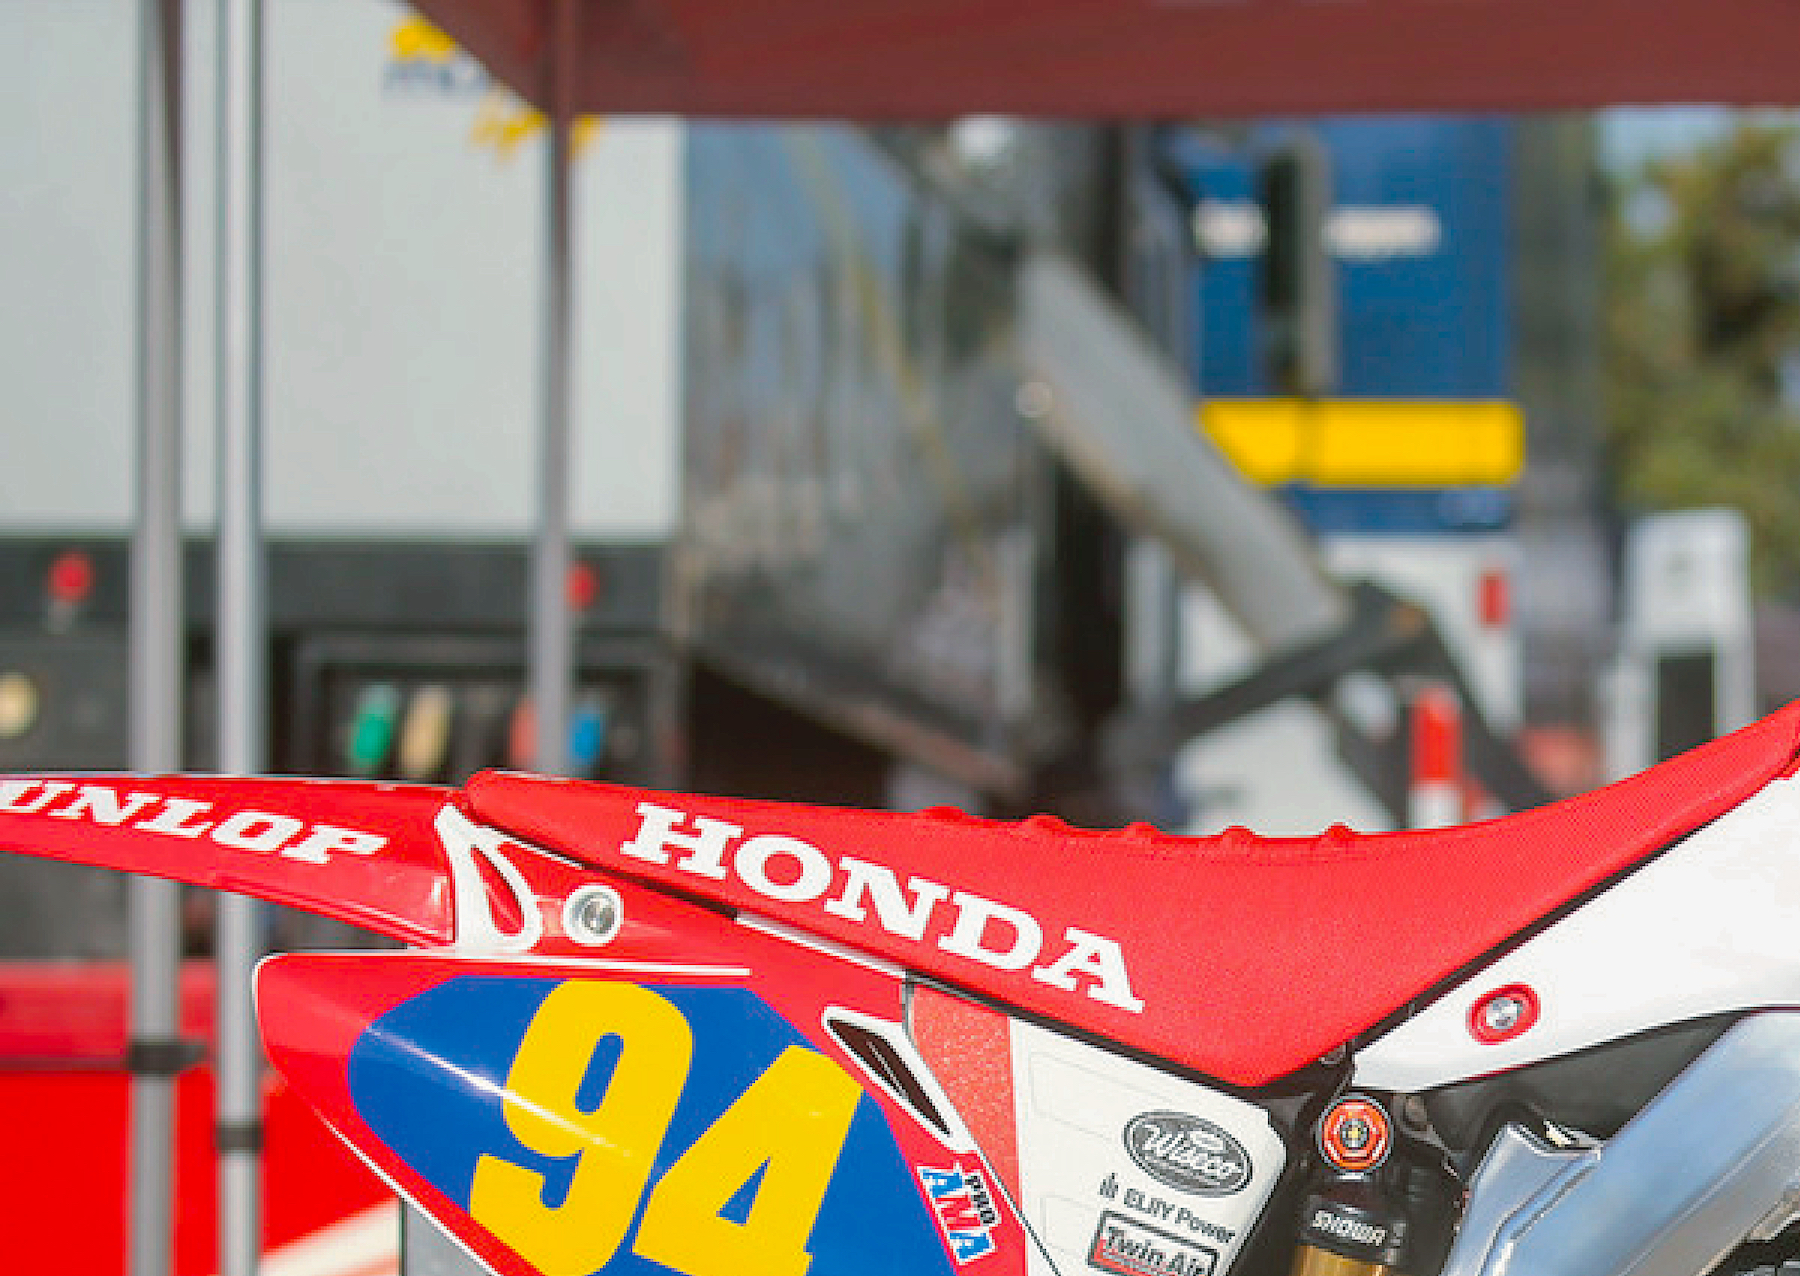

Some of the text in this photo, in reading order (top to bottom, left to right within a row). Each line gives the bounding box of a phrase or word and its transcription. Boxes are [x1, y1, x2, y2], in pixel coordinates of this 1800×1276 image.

[619, 802, 1145, 1014] HONDA
[917, 1167, 993, 1262] AMA
[964, 1173, 996, 1225] PRO
[1107, 1226, 1167, 1266] Twin
